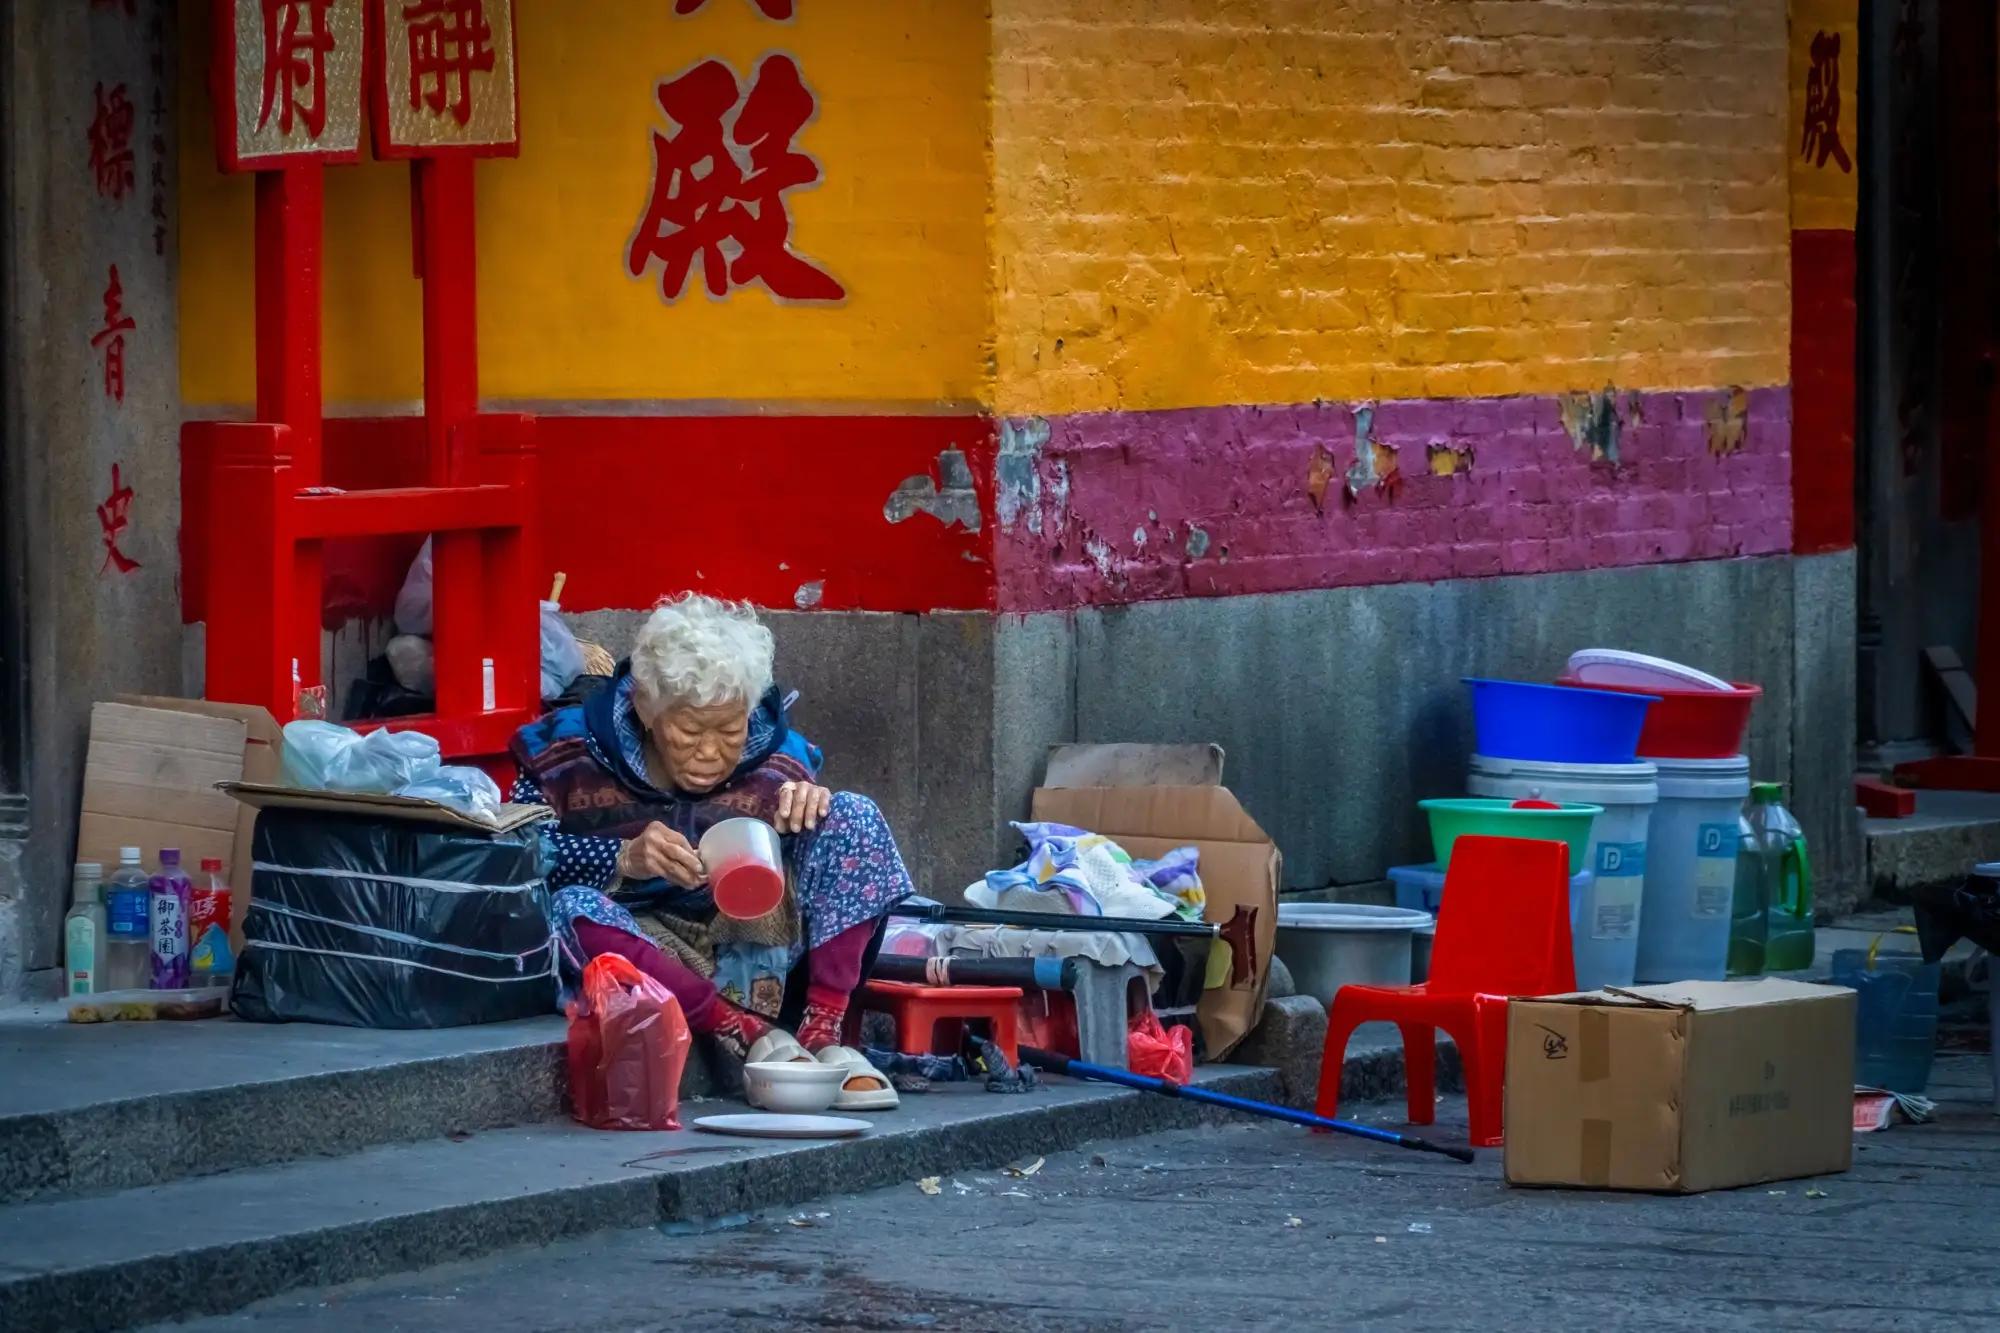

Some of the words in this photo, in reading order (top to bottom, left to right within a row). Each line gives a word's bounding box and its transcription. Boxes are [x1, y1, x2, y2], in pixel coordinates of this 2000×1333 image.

[88, 0, 141, 574] 標青史
[629, 0, 846, 300] 殿
[157, 899, 175, 955] 御茶園
